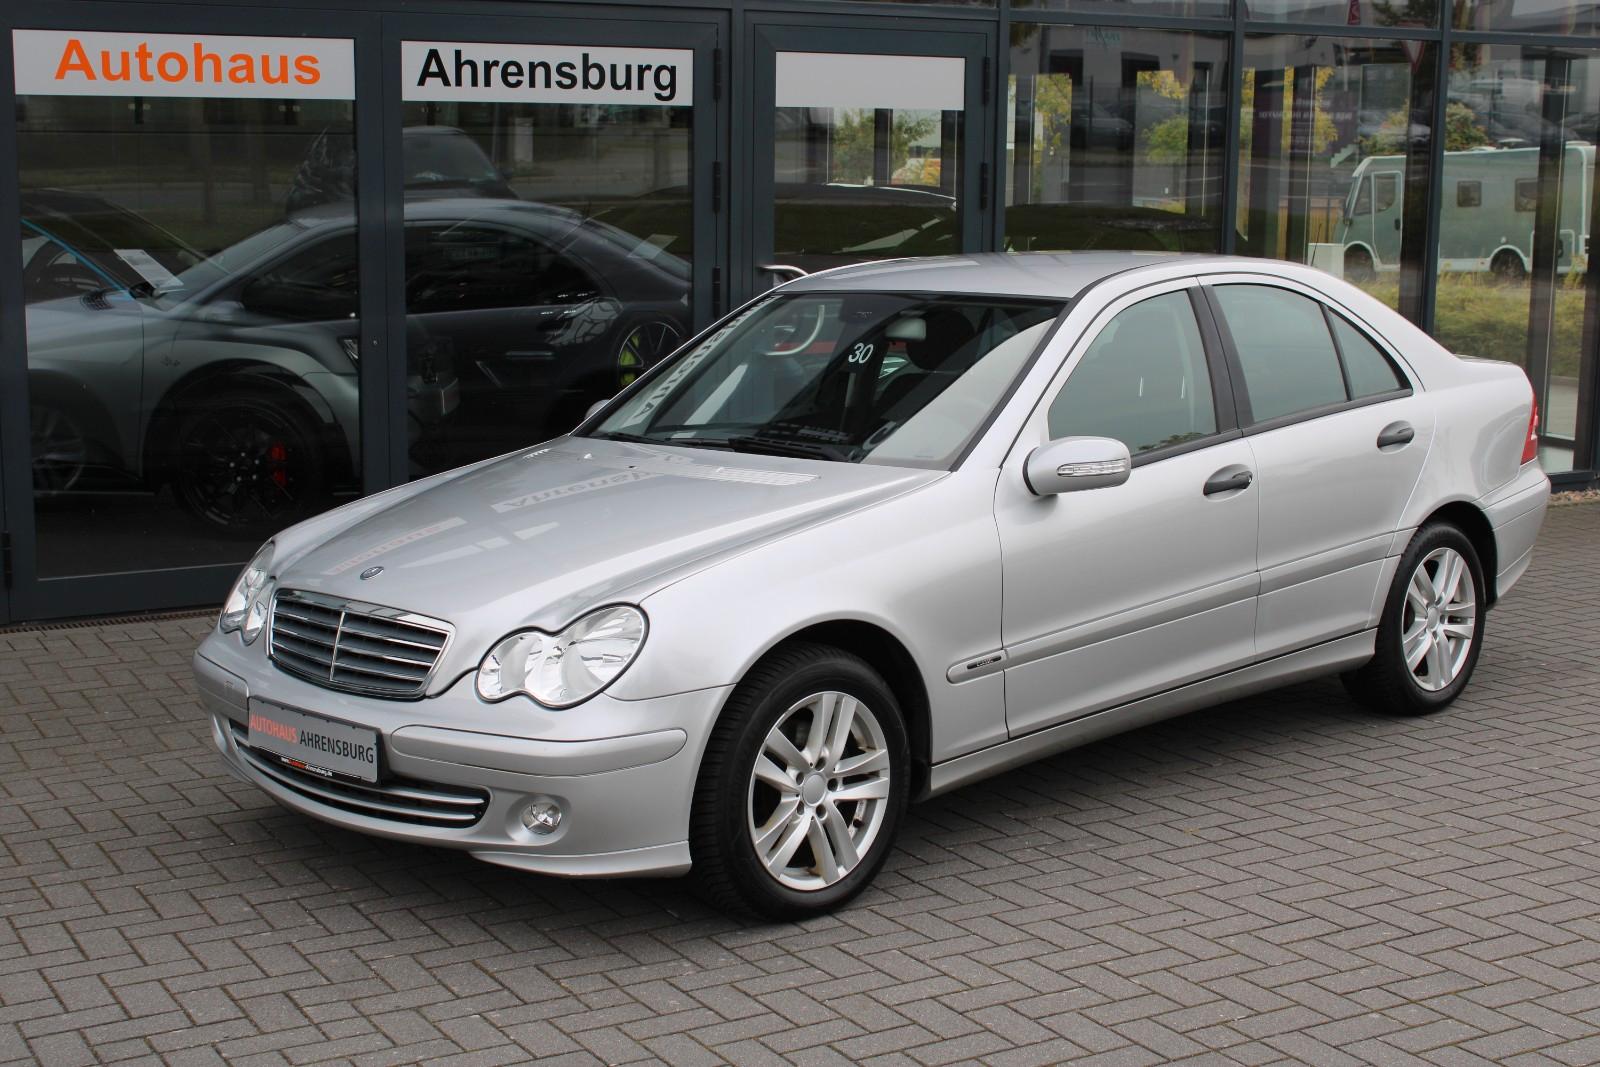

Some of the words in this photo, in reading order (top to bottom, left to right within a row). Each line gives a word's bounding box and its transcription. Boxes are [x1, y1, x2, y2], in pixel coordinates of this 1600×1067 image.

[55, 39, 320, 84] Autohaus
[417, 48, 677, 101] Ahrensburg
[848, 342, 874, 364] 30
[250, 713, 298, 743] AUTOHAUS
[300, 730, 374, 764] AHRENSBURG
